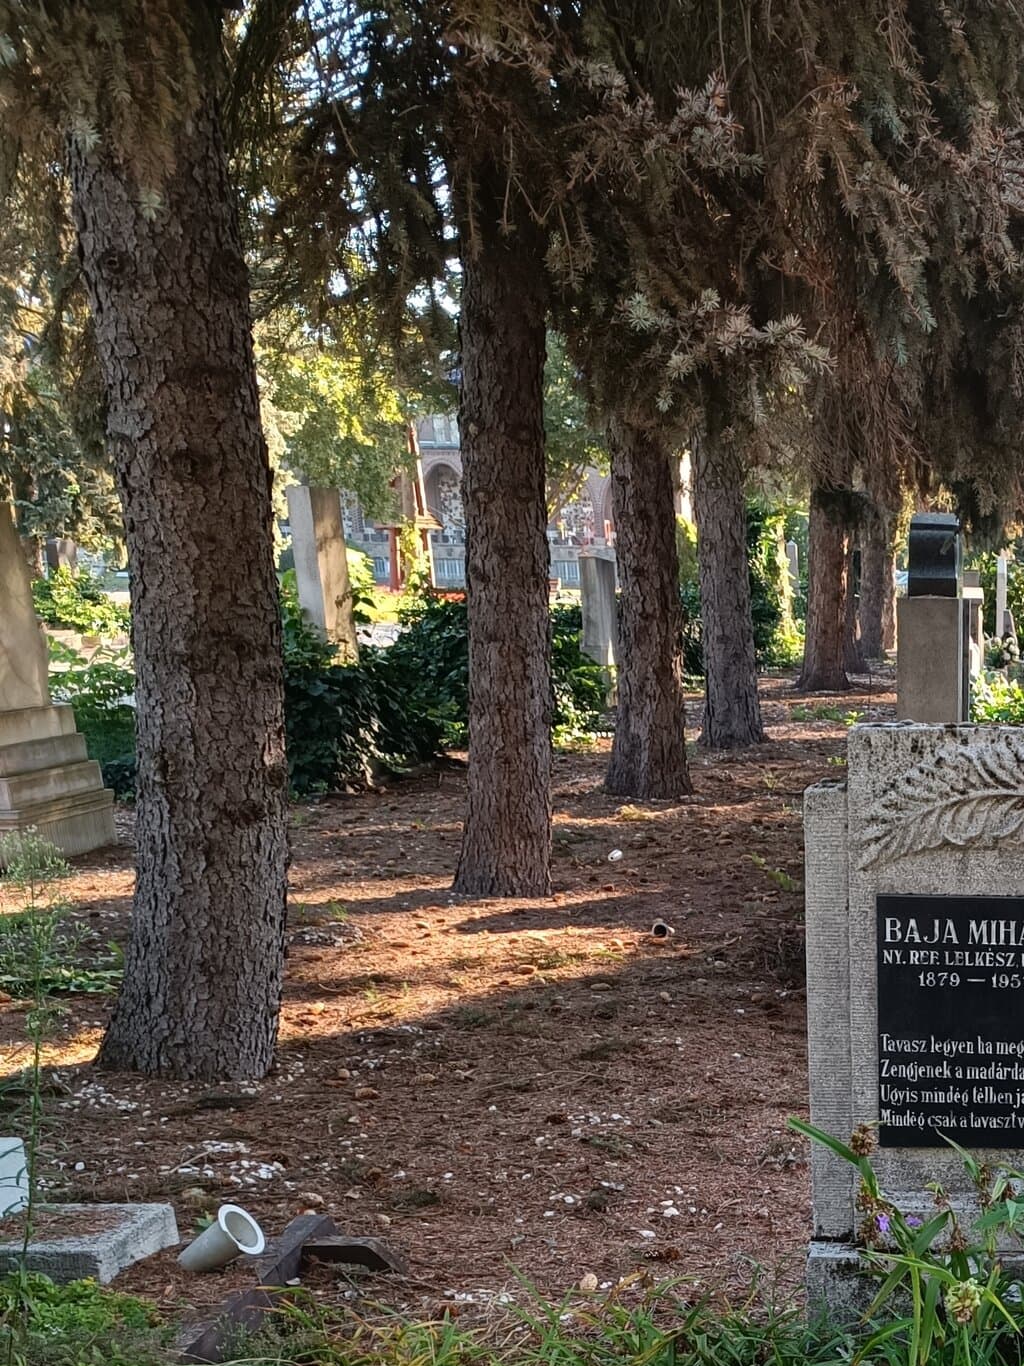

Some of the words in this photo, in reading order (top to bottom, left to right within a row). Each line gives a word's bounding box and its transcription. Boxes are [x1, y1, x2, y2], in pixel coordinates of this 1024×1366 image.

[884, 917, 960, 944] BAJA
[882, 949, 907, 966] NY.
[909, 950, 940, 966] REF.
[918, 970, 961, 988] 1879
[880, 1033, 928, 1053] Tavasz
[930, 1034, 975, 1058] legyen
[977, 1035, 993, 1055] ha
[880, 1058, 953, 1082] Zengjenek
[954, 1065, 963, 1079] a
[920, 1085, 970, 1107] mindég
[972, 1085, 1014, 1105] télben
[880, 1108, 926, 1131] Mindég
[927, 1109, 958, 1128] csak
[959, 1115, 968, 1129] a
[969, 1111, 1017, 1129] tavaszt
